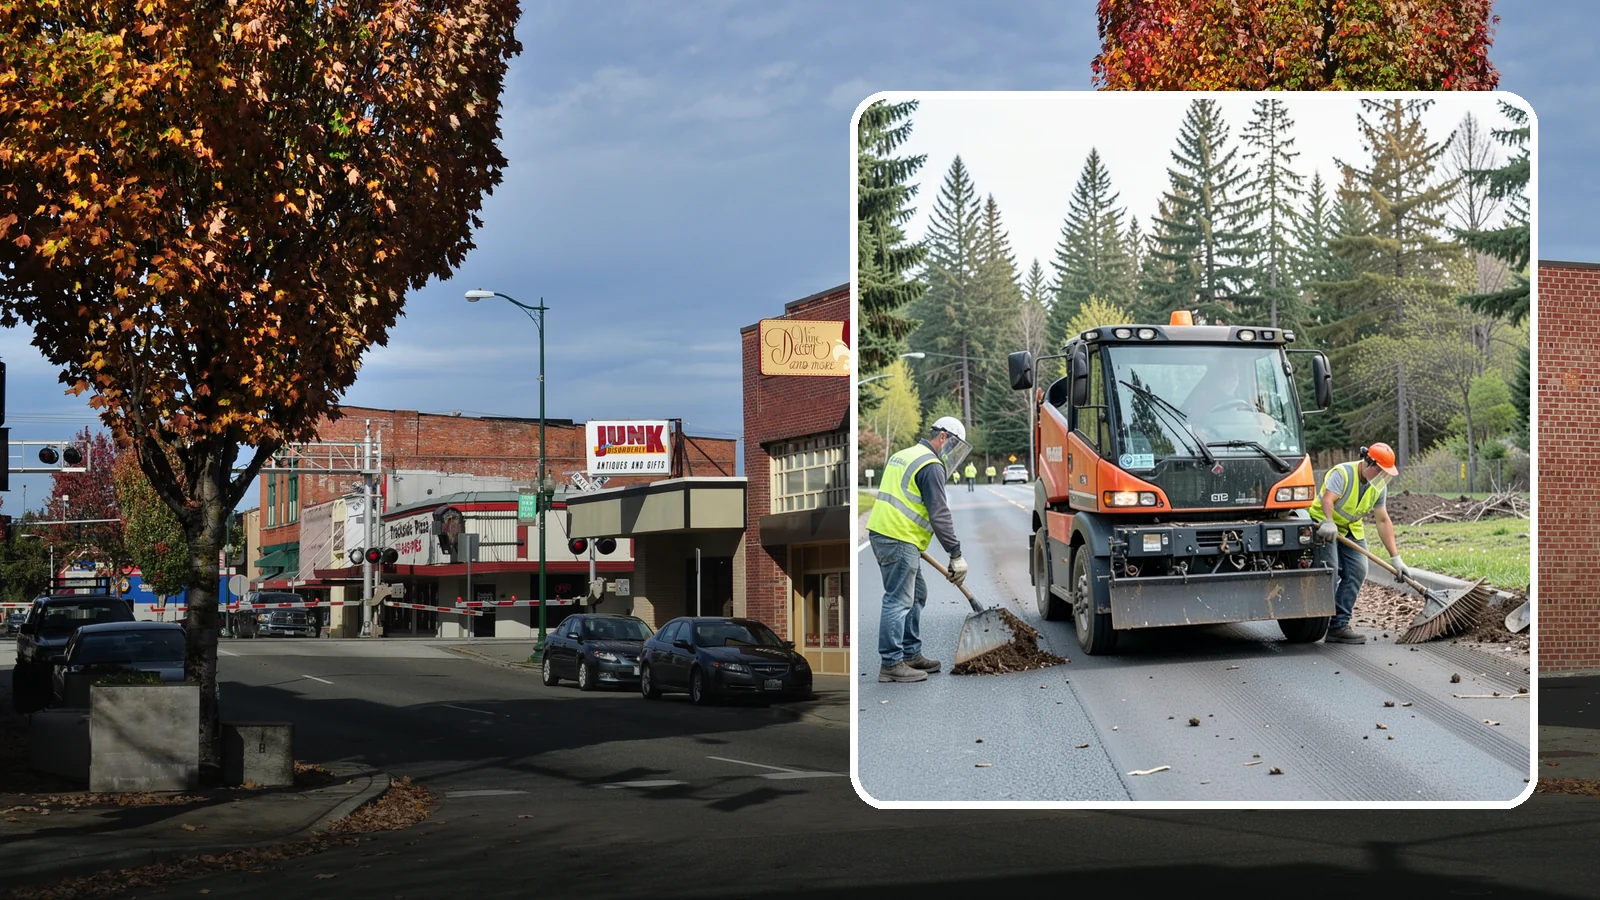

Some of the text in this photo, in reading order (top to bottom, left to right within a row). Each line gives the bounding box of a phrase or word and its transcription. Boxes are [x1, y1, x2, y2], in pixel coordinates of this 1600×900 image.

[595, 425, 665, 457] JUNK
[607, 446, 646, 454] DISORDERLY
[597, 460, 665, 470] ANTIQUES AND GIFTS
[414, 519, 429, 535] Pizza
